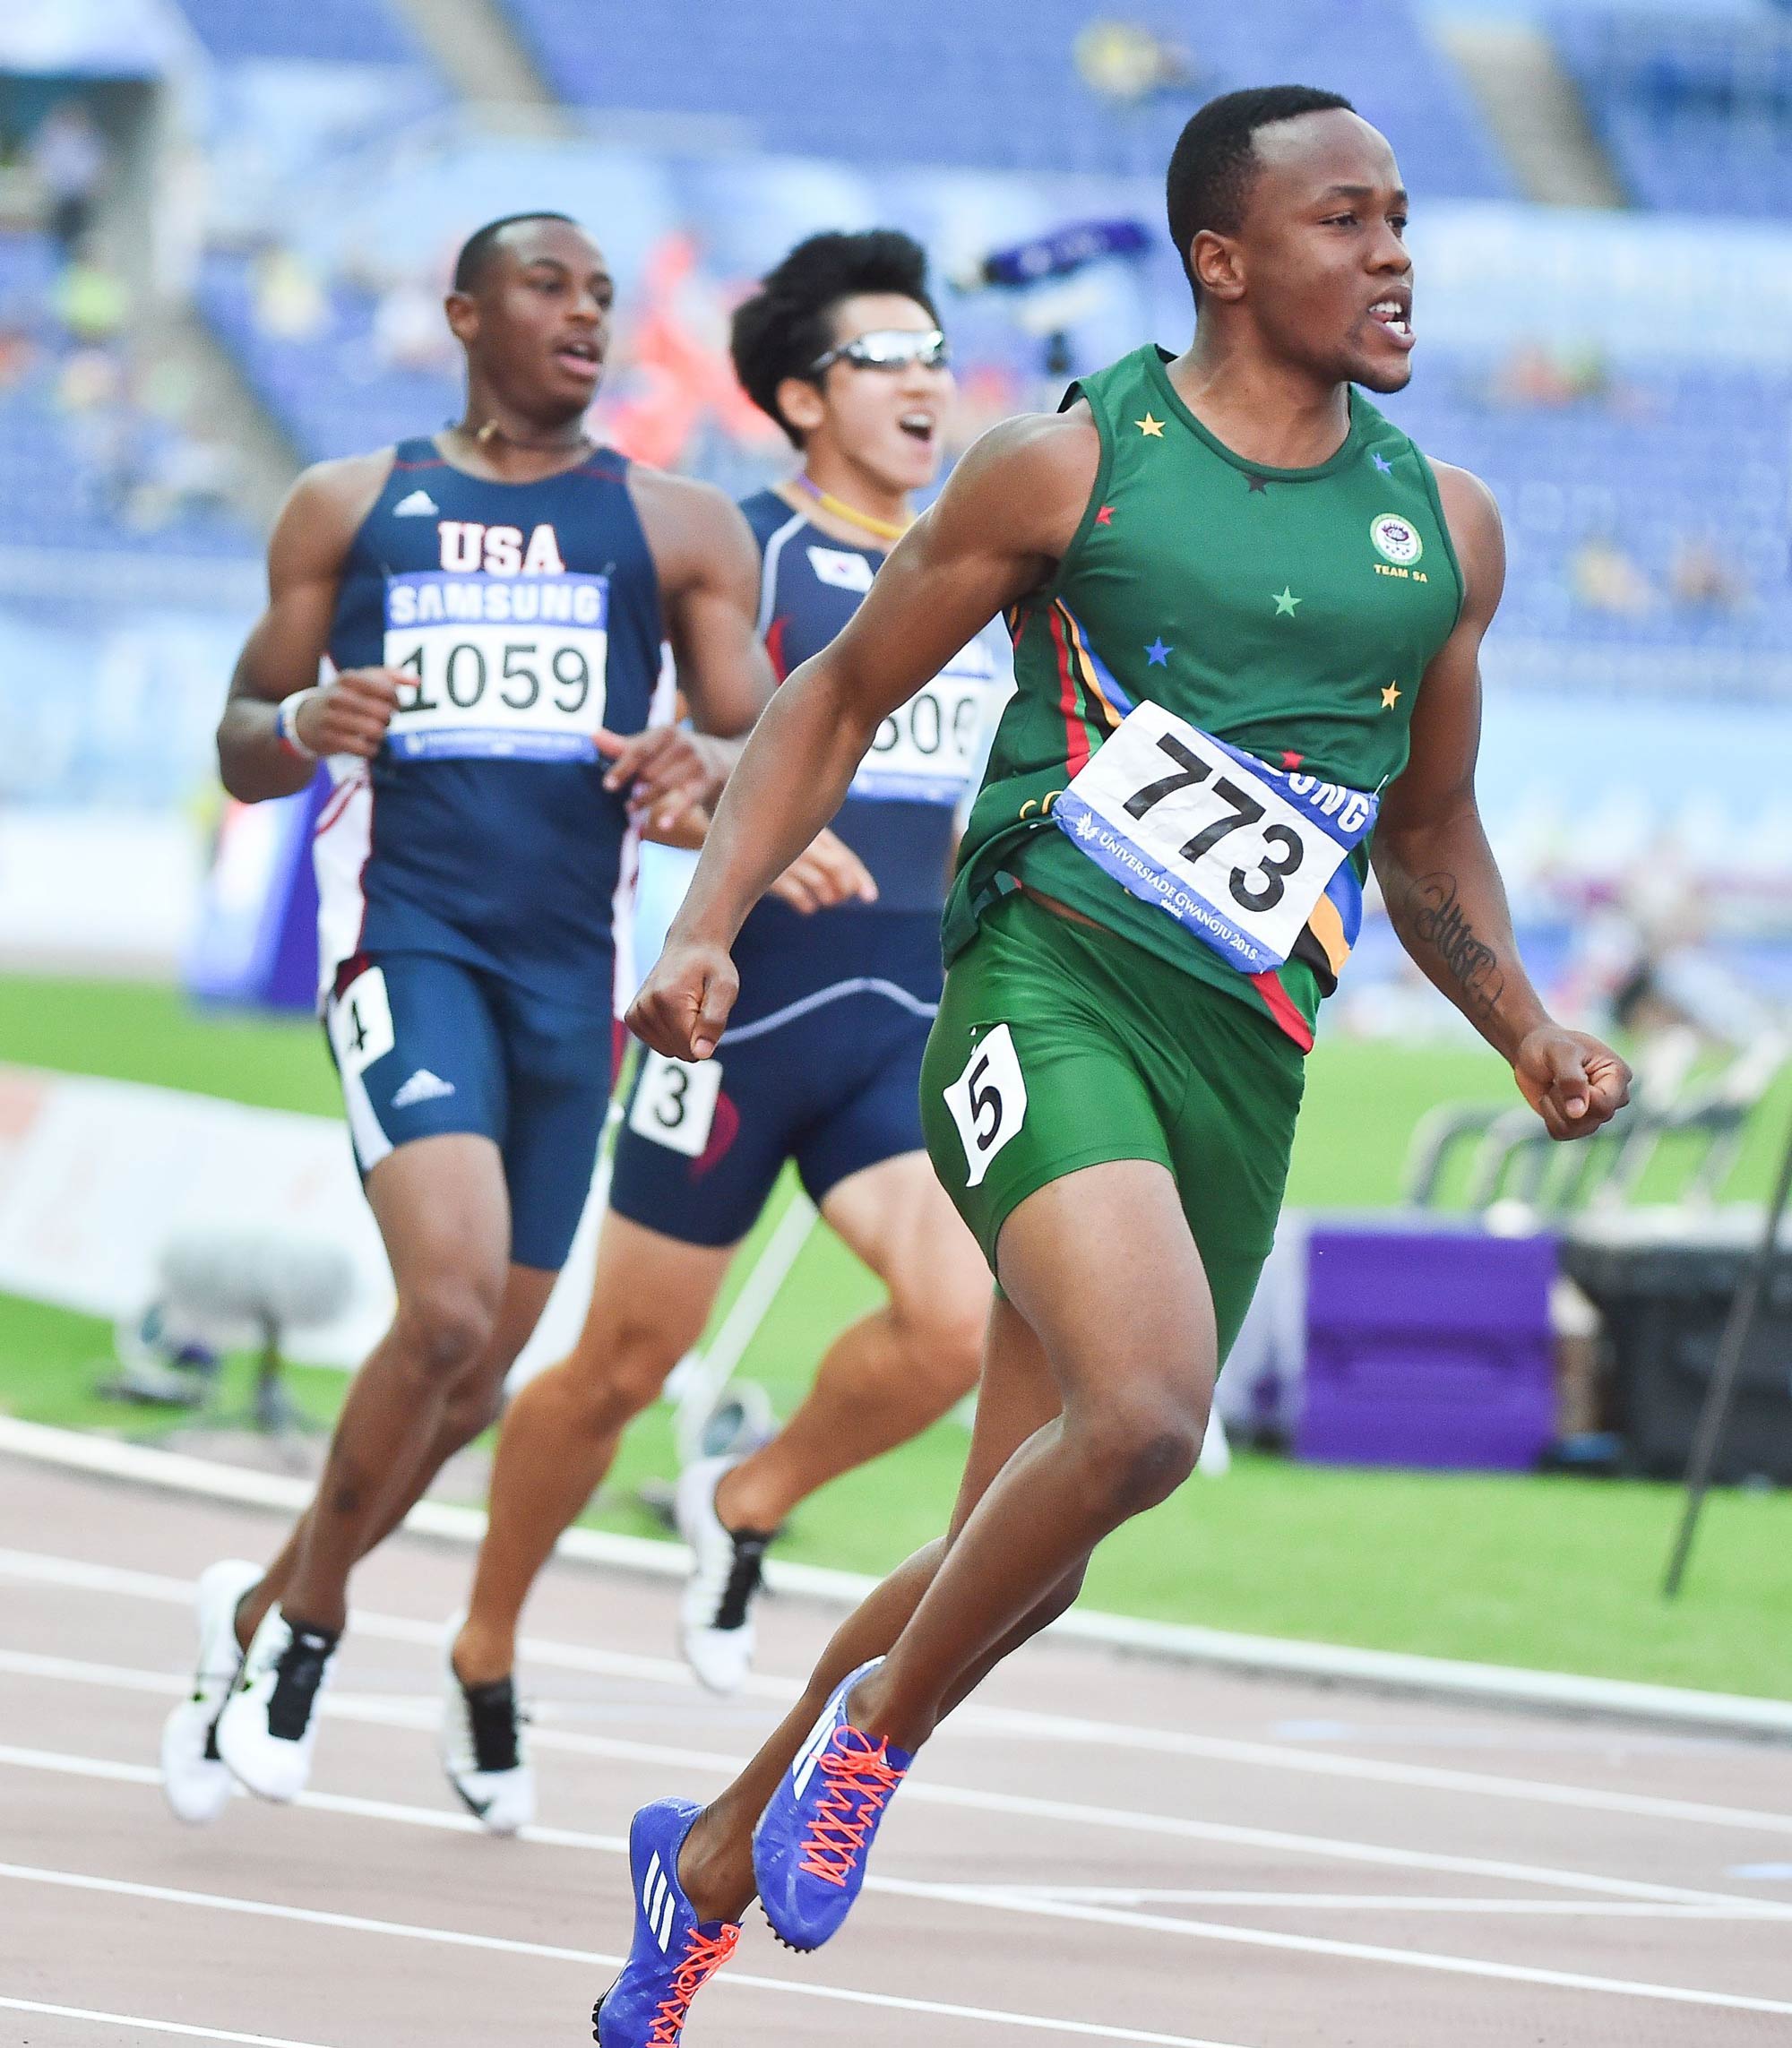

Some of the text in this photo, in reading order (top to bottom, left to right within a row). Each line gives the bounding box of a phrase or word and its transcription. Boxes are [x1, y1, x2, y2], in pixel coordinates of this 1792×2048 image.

[437, 520, 566, 576] USA
[1374, 564, 1428, 583] TEAM SA
[389, 582, 601, 624] SAMSUNG
[398, 643, 589, 713] 1059
[1123, 732, 1304, 912] 773
[1099, 831, 1176, 898] UNIVERSIADE
[1175, 891, 1232, 941] GWANGJU
[1228, 933, 1259, 960] 2015
[653, 1064, 688, 1129] 3
[969, 1053, 1004, 1151] 5
